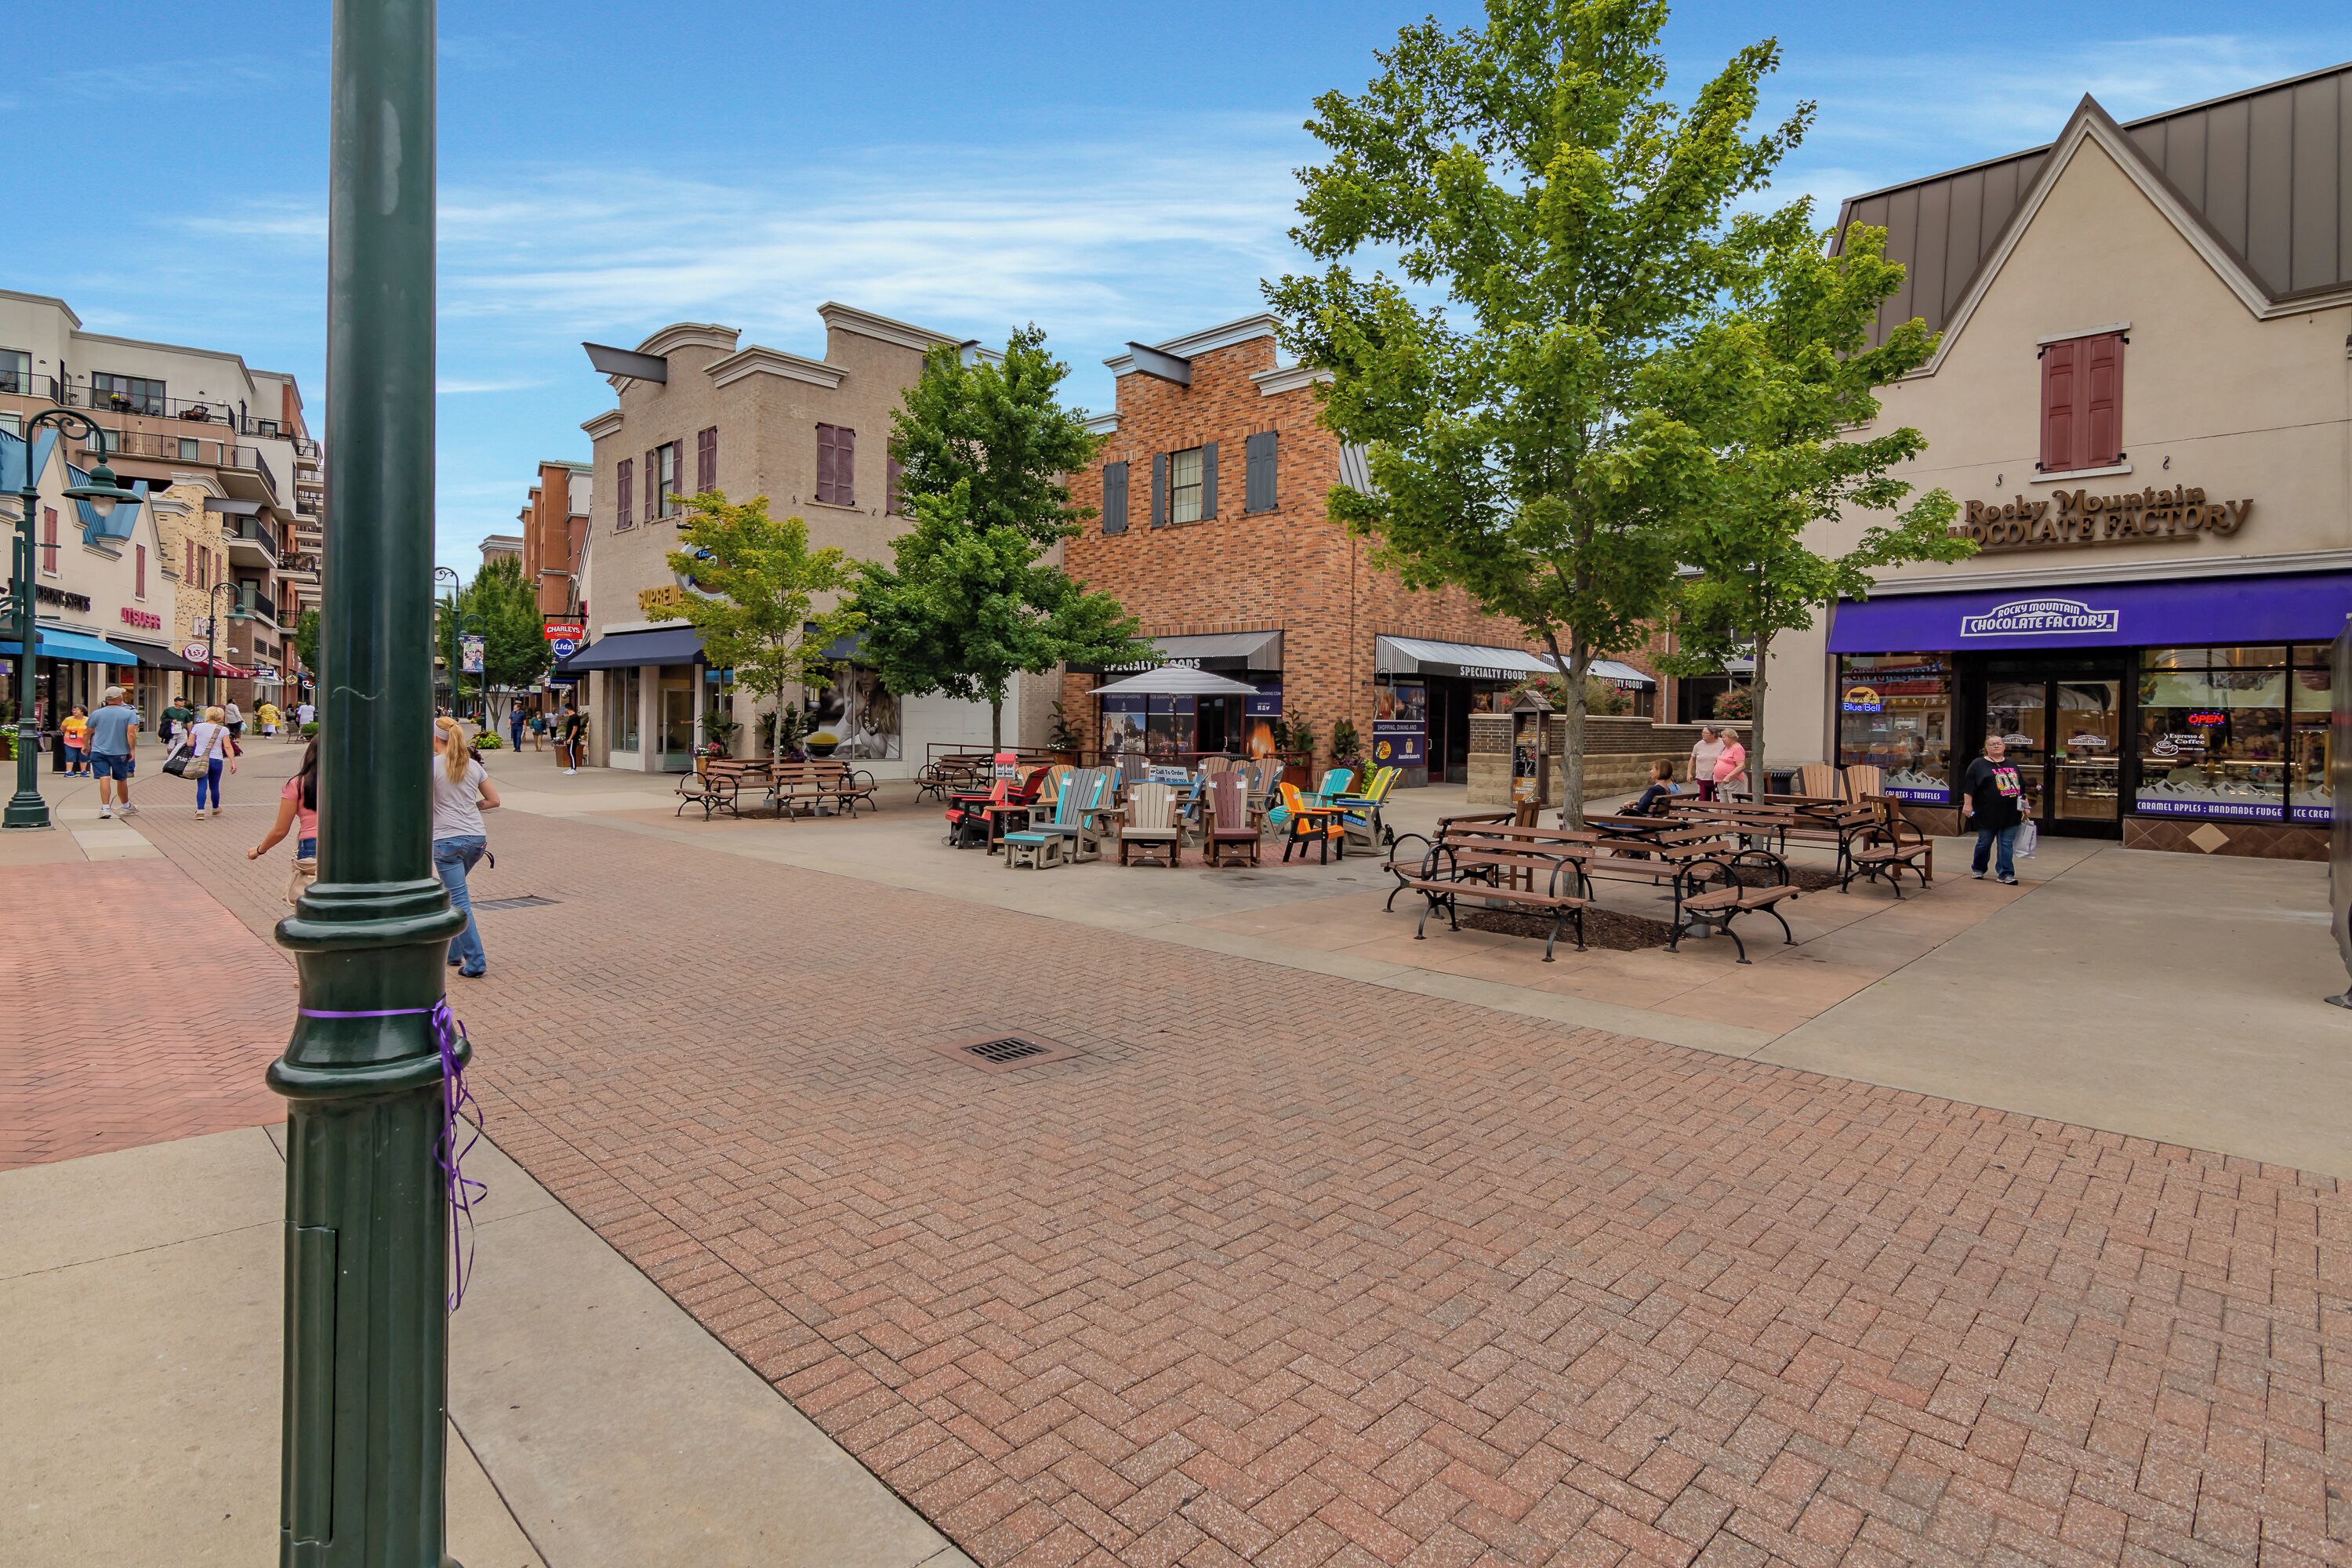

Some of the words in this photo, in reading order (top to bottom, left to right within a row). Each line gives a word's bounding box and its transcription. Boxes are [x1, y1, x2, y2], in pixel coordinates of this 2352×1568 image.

[1964, 495, 2049, 524] Rocky
[2052, 483, 2206, 515] Mountain
[1947, 514, 2096, 544] HOCOLATE
[2103, 498, 2254, 536] FACTORY
[1998, 604, 2027, 618] ROCKY
[2029, 602, 2080, 615] MOUNTAIN
[1970, 617, 2043, 633] CHOCOLATE
[1168, 658, 1200, 670] OODS
[1460, 666, 1501, 678] SPECIALTY
[1503, 670, 1527, 681] FOODS
[1843, 702, 1863, 711] Blue
[1864, 702, 1881, 712] Bell
[2188, 714, 2224, 724] OPEN
[2137, 801, 2172, 811] CARAMEL
[2174, 804, 2201, 812] APPLES
[2209, 804, 2254, 815] HANDMADE
[2256, 808, 2282, 817] FUDGE
[2293, 809, 2307, 818] ICE
[2308, 810, 2332, 819] CREA
